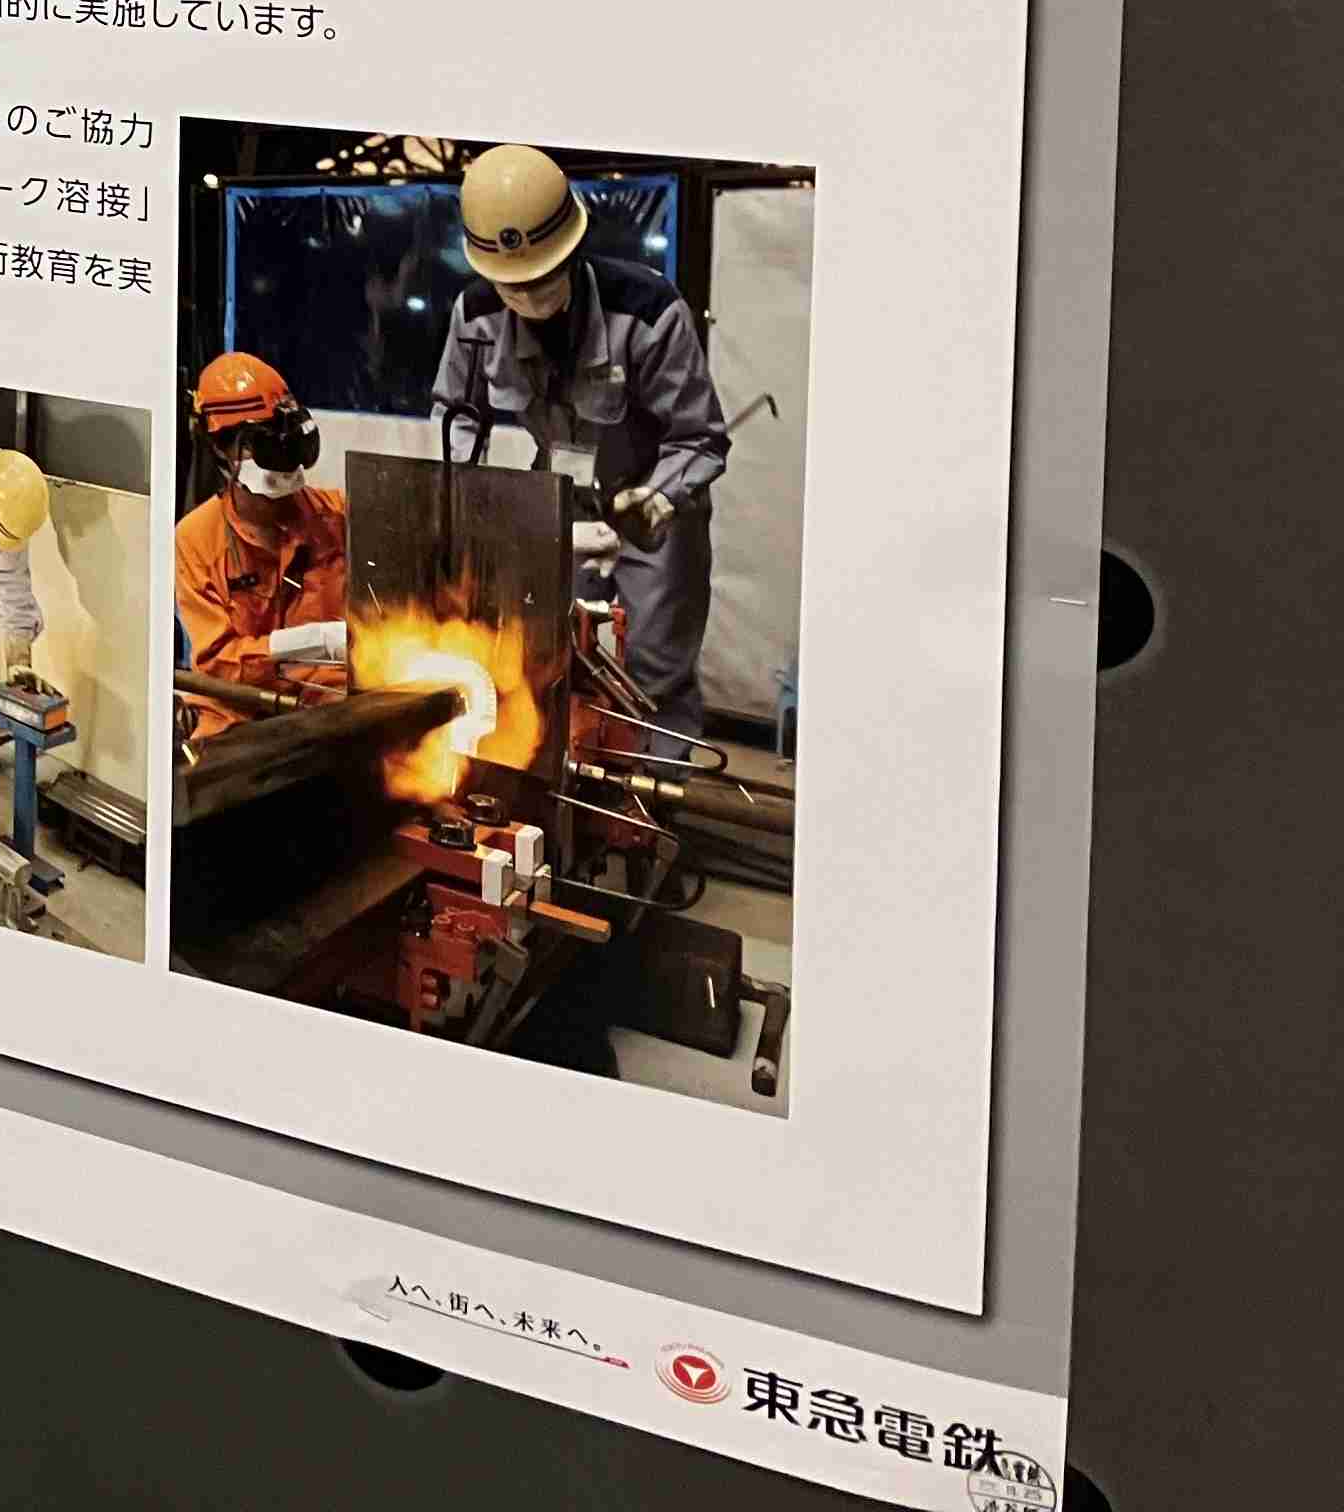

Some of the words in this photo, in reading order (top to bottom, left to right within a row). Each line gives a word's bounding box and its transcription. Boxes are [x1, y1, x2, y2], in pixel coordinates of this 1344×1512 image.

[388, 1274, 603, 1352] 人へ、街へ、未来へ。
[743, 1366, 1004, 1477] 東急電鉄
